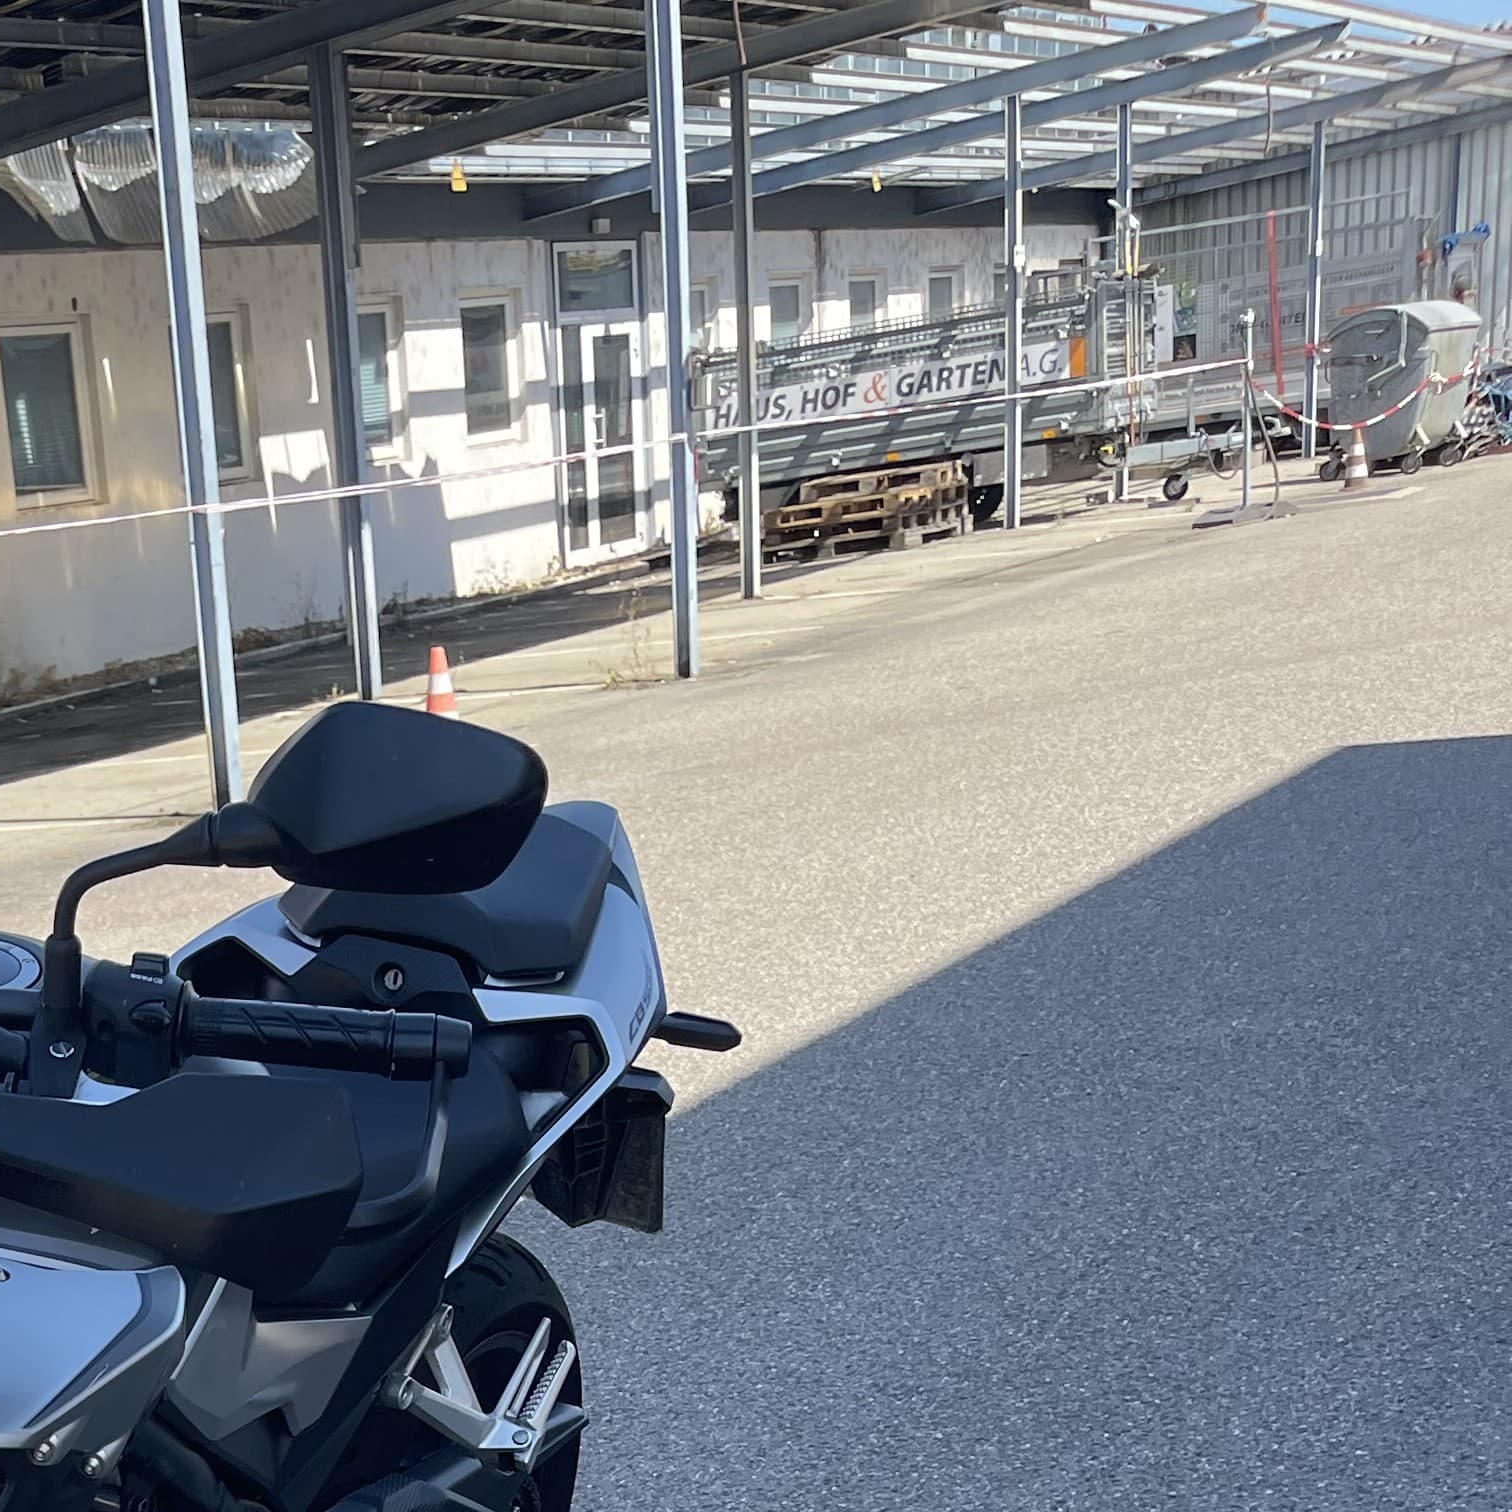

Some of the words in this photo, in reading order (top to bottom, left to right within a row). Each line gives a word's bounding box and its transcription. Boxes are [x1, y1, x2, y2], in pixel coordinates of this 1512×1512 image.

[800, 382, 857, 415] HOF
[863, 372, 888, 404] &
[896, 357, 1005, 396] GARTEN
